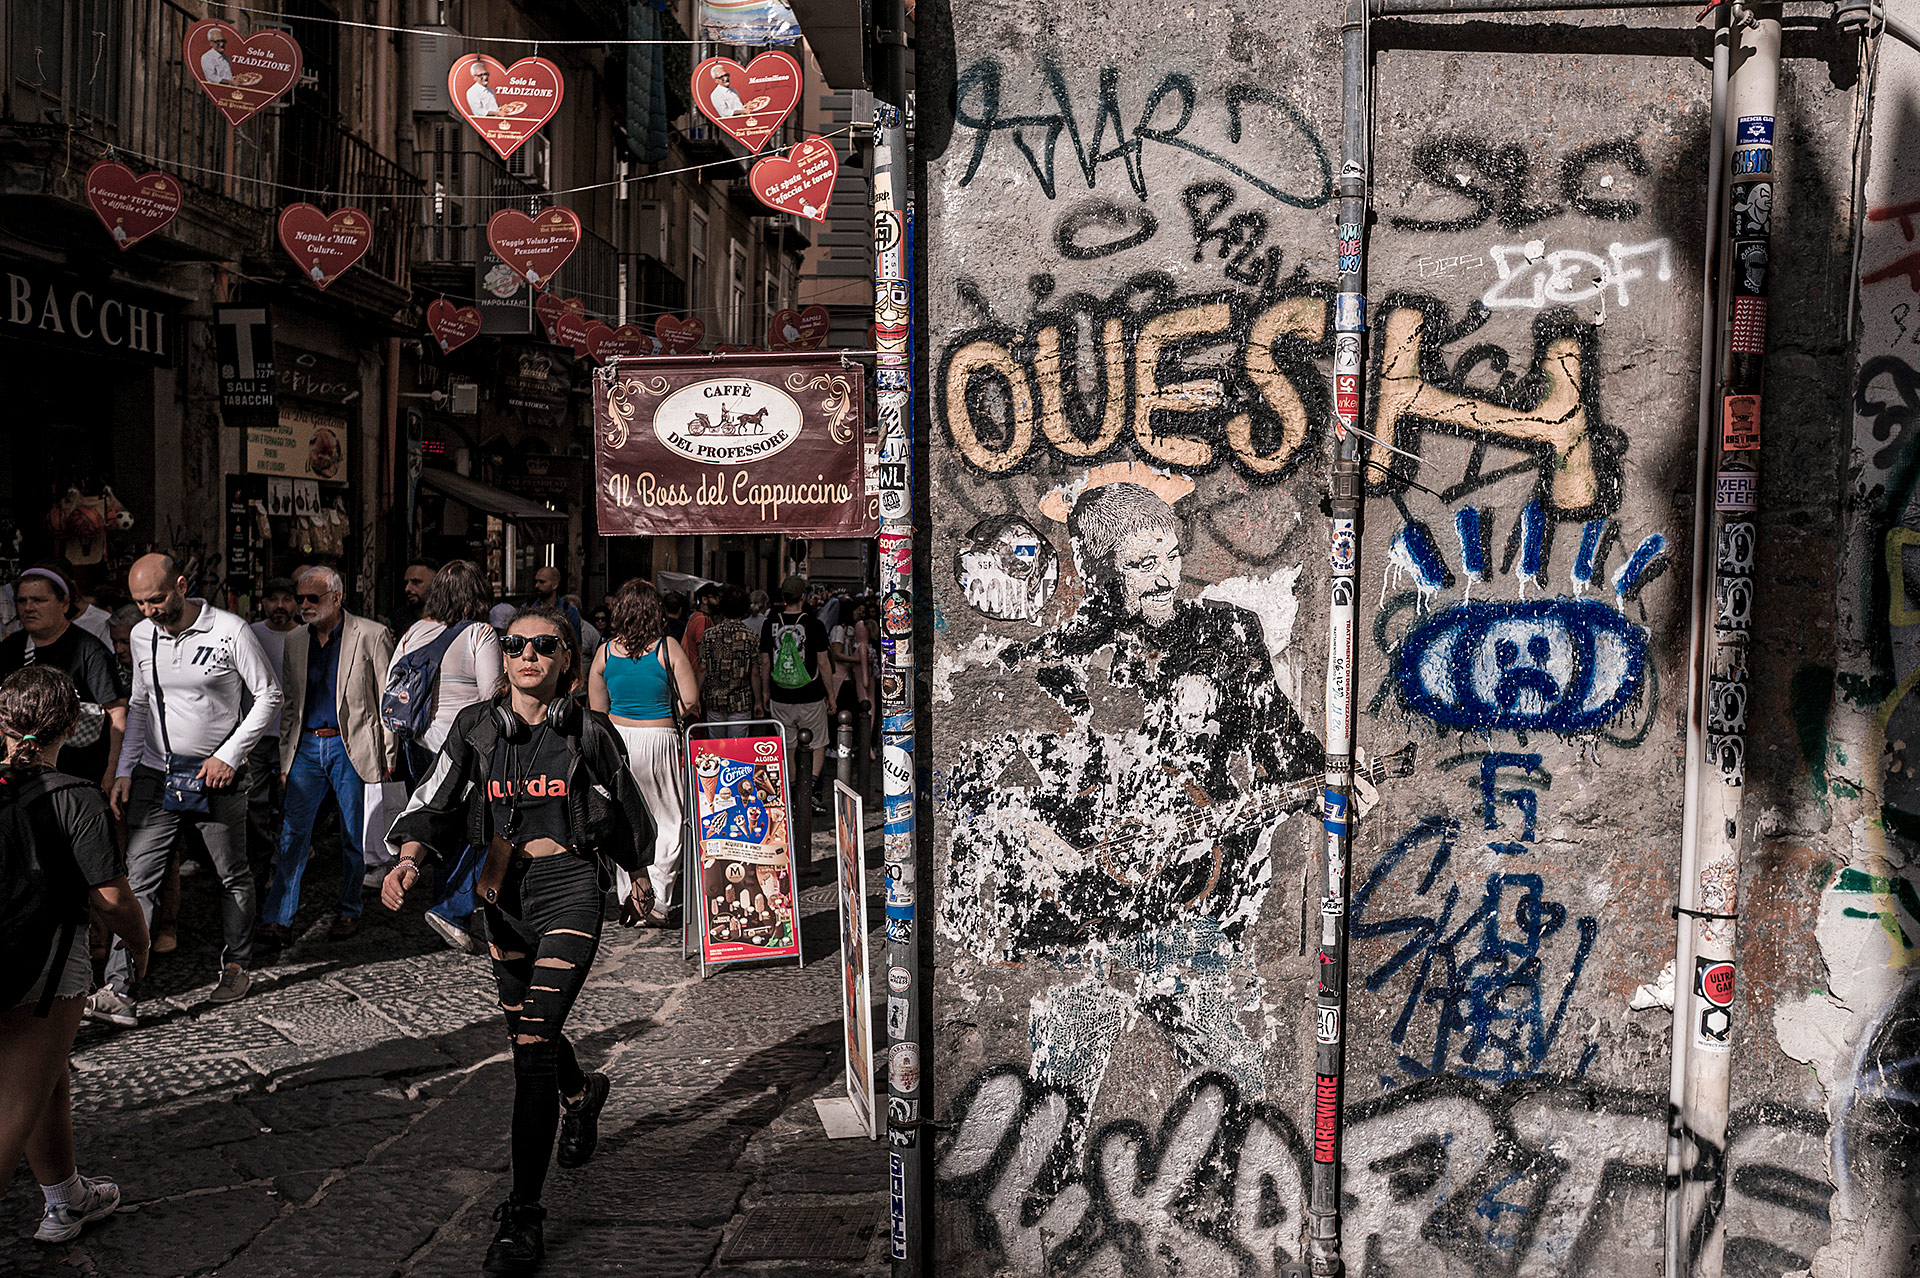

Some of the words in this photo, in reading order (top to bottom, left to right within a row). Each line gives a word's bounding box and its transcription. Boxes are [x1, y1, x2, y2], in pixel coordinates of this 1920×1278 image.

[247, 47, 265, 57] Solo
[266, 50, 275, 59] la
[232, 55, 291, 72] TRADIZIONE
[509, 77, 527, 86] Solo
[528, 78, 536, 86] la
[496, 86, 553, 98] TRADIZIONE
[765, 182, 779, 197] Chi
[779, 173, 802, 190] sputa
[803, 179, 812, 189] le
[811, 169, 834, 185] torna
[89, 186, 97, 194] A
[130, 195, 154, 207] TUTT
[153, 202, 177, 213] capace
[108, 200, 135, 212] difficile
[295, 231, 326, 243] Napule
[526, 237, 548, 246] Voluto
[0, 272, 166, 356] BACCHI
[219, 308, 266, 379] T
[226, 382, 255, 392] SALI
[703, 383, 752, 399] CAFFÈ
[223, 395, 273, 406] TABACCHI
[666, 431, 694, 454] DEL
[697, 429, 789, 460] PROFESSORE
[608, 472, 633, 508] Il
[636, 471, 692, 507] Boss
[696, 471, 728, 506] del
[732, 471, 853, 521] Cappuccino
[719, 765, 753, 788] Cornetto
[1313, 1075, 1337, 1163] BARBWIRE
